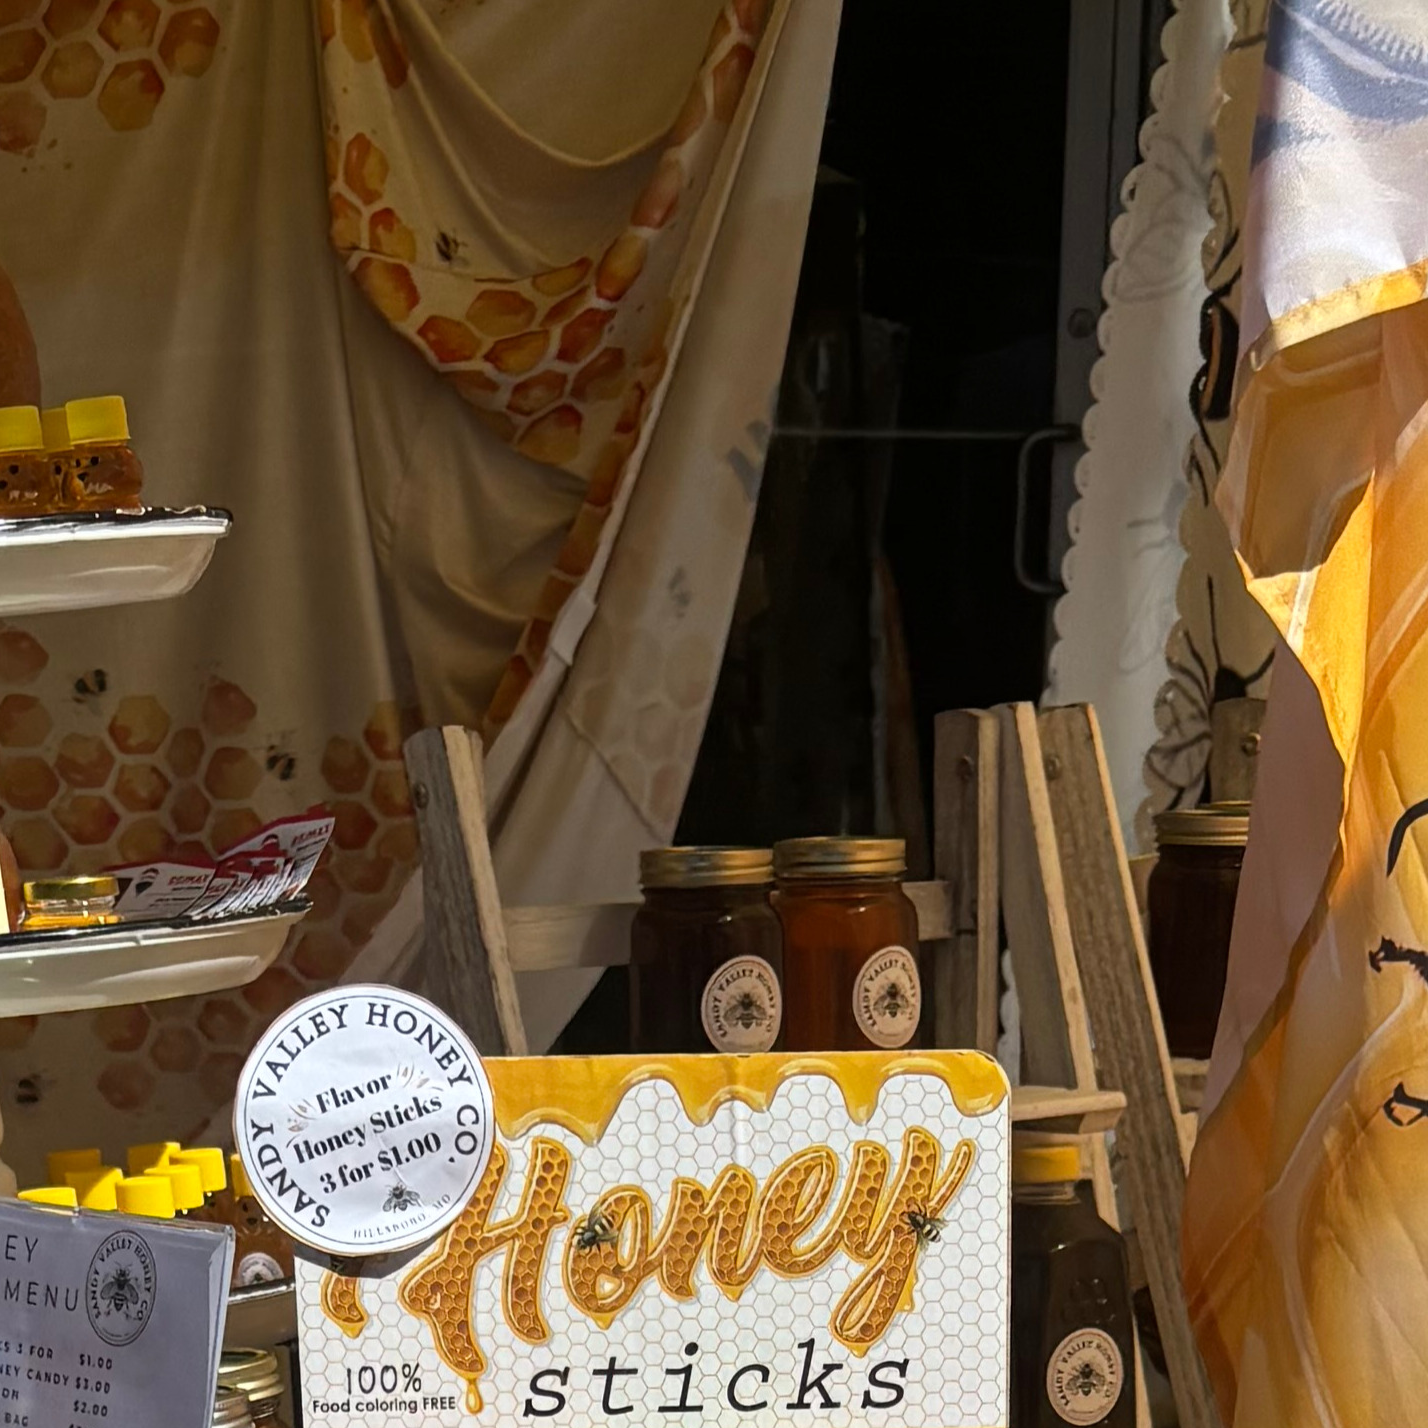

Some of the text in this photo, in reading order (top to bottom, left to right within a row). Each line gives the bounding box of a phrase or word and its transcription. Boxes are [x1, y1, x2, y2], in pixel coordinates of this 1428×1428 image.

[252, 1003, 349, 1101] VALLEY
[365, 1002, 473, 1087] HONEY
[316, 1073, 392, 1115] Flavor
[293, 1096, 443, 1164] Honey Sticks
[251, 1118, 330, 1228] SANDY
[320, 1132, 442, 1194] 3 for $1.00
[320, 1125, 977, 1378] Honey
[4, 1278, 79, 1312] MENU
[30, 1345, 53, 1360] FOR
[79, 1353, 113, 1371] $1.00
[347, 1362, 422, 1395] 100%
[521, 1336, 911, 1420] sticks
[27, 1368, 70, 1387] CANDY
[75, 1376, 111, 1394] $3.00
[4, 1412, 29, 1427] BAG
[73, 1400, 108, 1417] $2.00
[312, 1396, 456, 1415] Food coloring FREE
